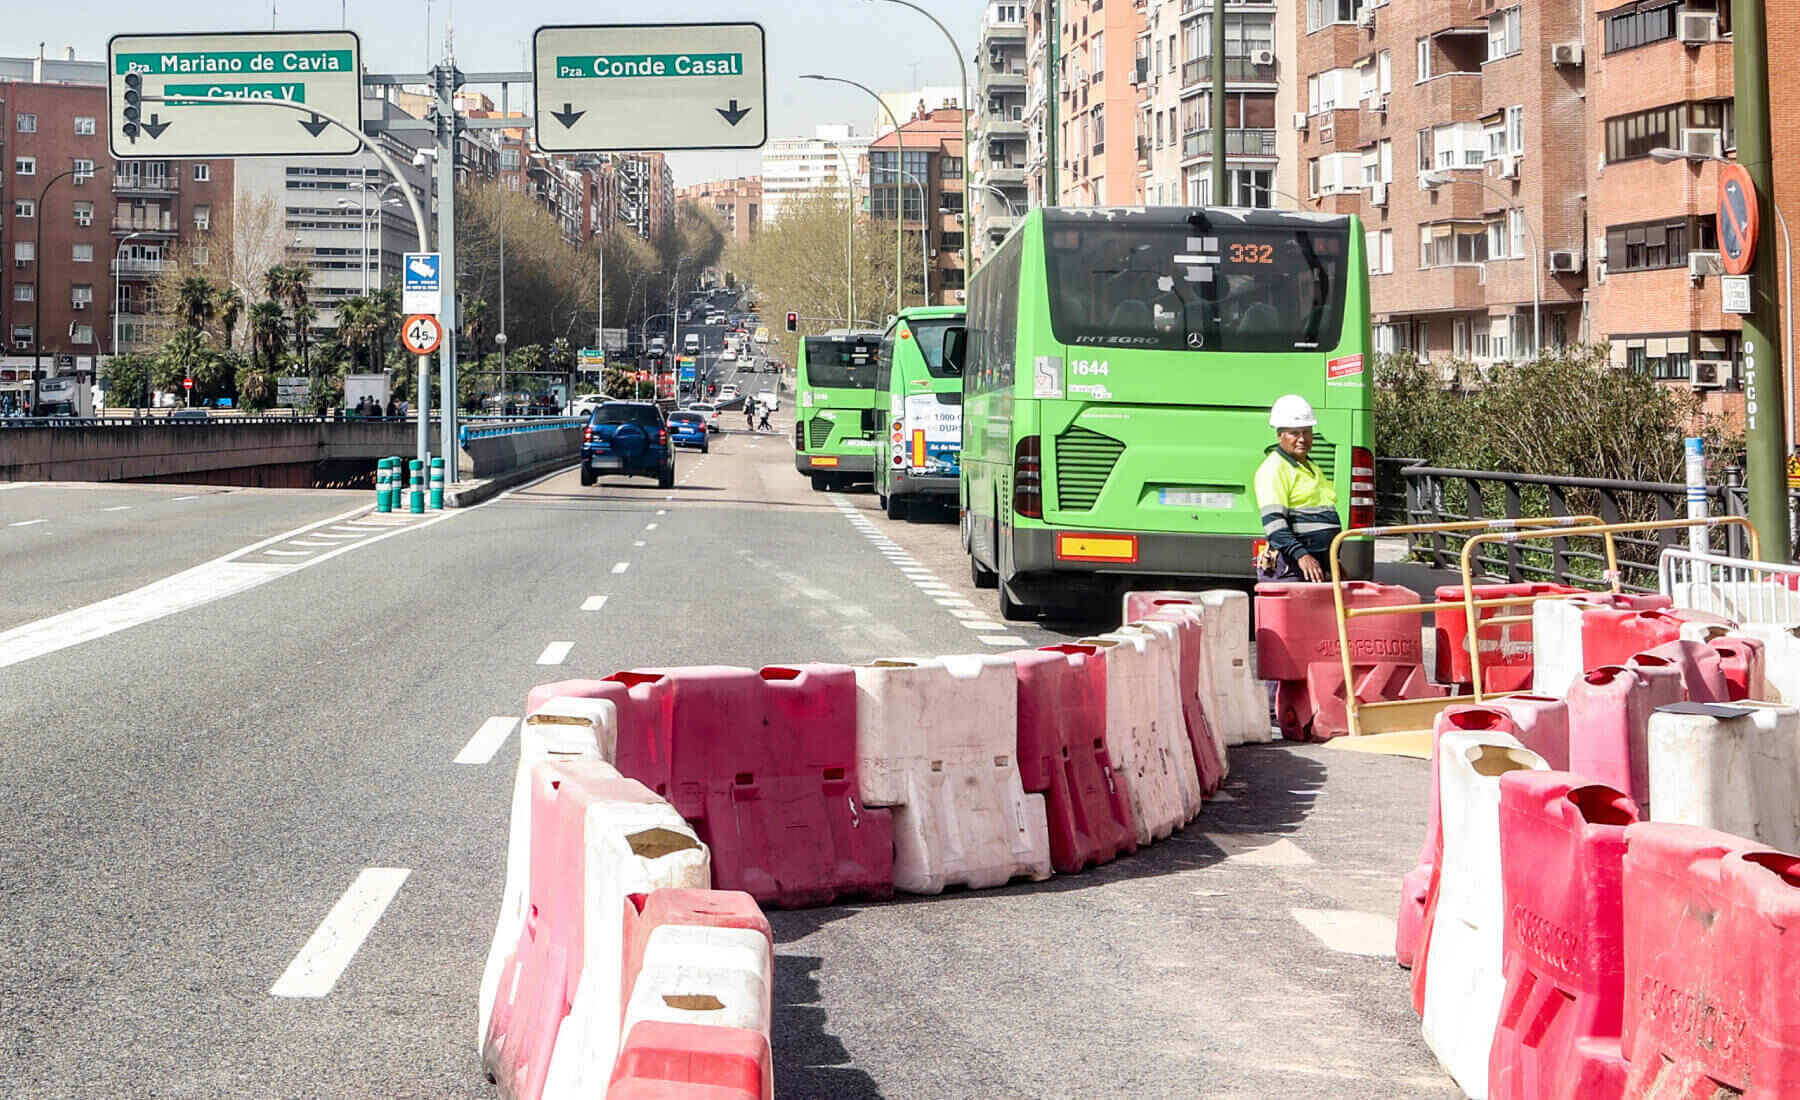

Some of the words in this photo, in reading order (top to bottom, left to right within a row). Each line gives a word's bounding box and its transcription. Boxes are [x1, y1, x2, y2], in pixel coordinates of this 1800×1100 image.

[128, 62, 153, 73] Pza.
[160, 55, 242, 72] Mariano
[250, 54, 274, 71] de
[283, 53, 339, 71] Cavia
[560, 66, 587, 77] Pza.
[593, 56, 665, 76] Conde
[675, 55, 738, 74] Casal
[281, 85, 295, 101] V
[1230, 243, 1273, 264] 332
[1075, 335, 1160, 344] INTEGRO
[1071, 359, 1109, 376] 1644
